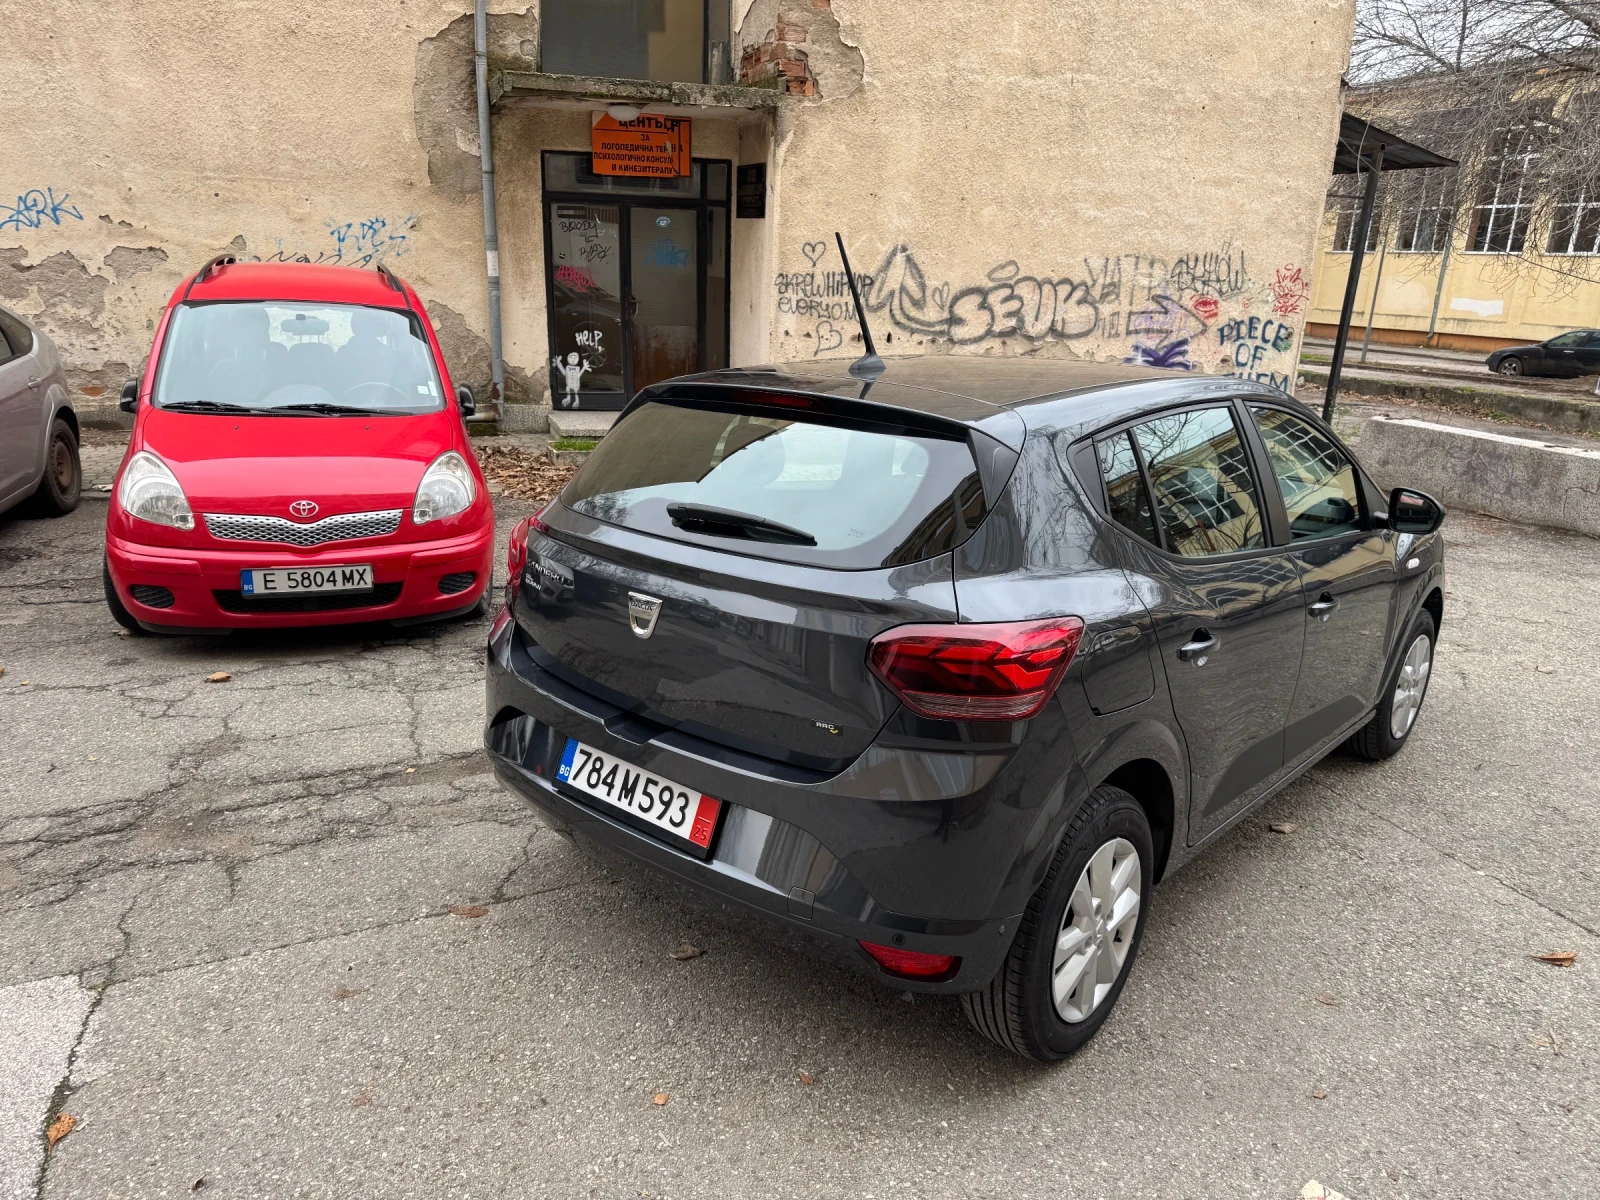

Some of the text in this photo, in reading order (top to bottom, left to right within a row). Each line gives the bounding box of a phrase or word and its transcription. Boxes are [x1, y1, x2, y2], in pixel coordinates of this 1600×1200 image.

[601, 142, 653, 152] ЛОГОПЕДИЧНА
[593, 152, 645, 162] ПСИХОЛОГИЧНО
[1235, 342, 1267, 370] OF
[263, 573, 277, 590] E
[287, 571, 338, 589] 5804
[341, 569, 368, 587] MX
[631, 601, 653, 611] DACIA
[559, 748, 708, 841] BG 784M593 25
